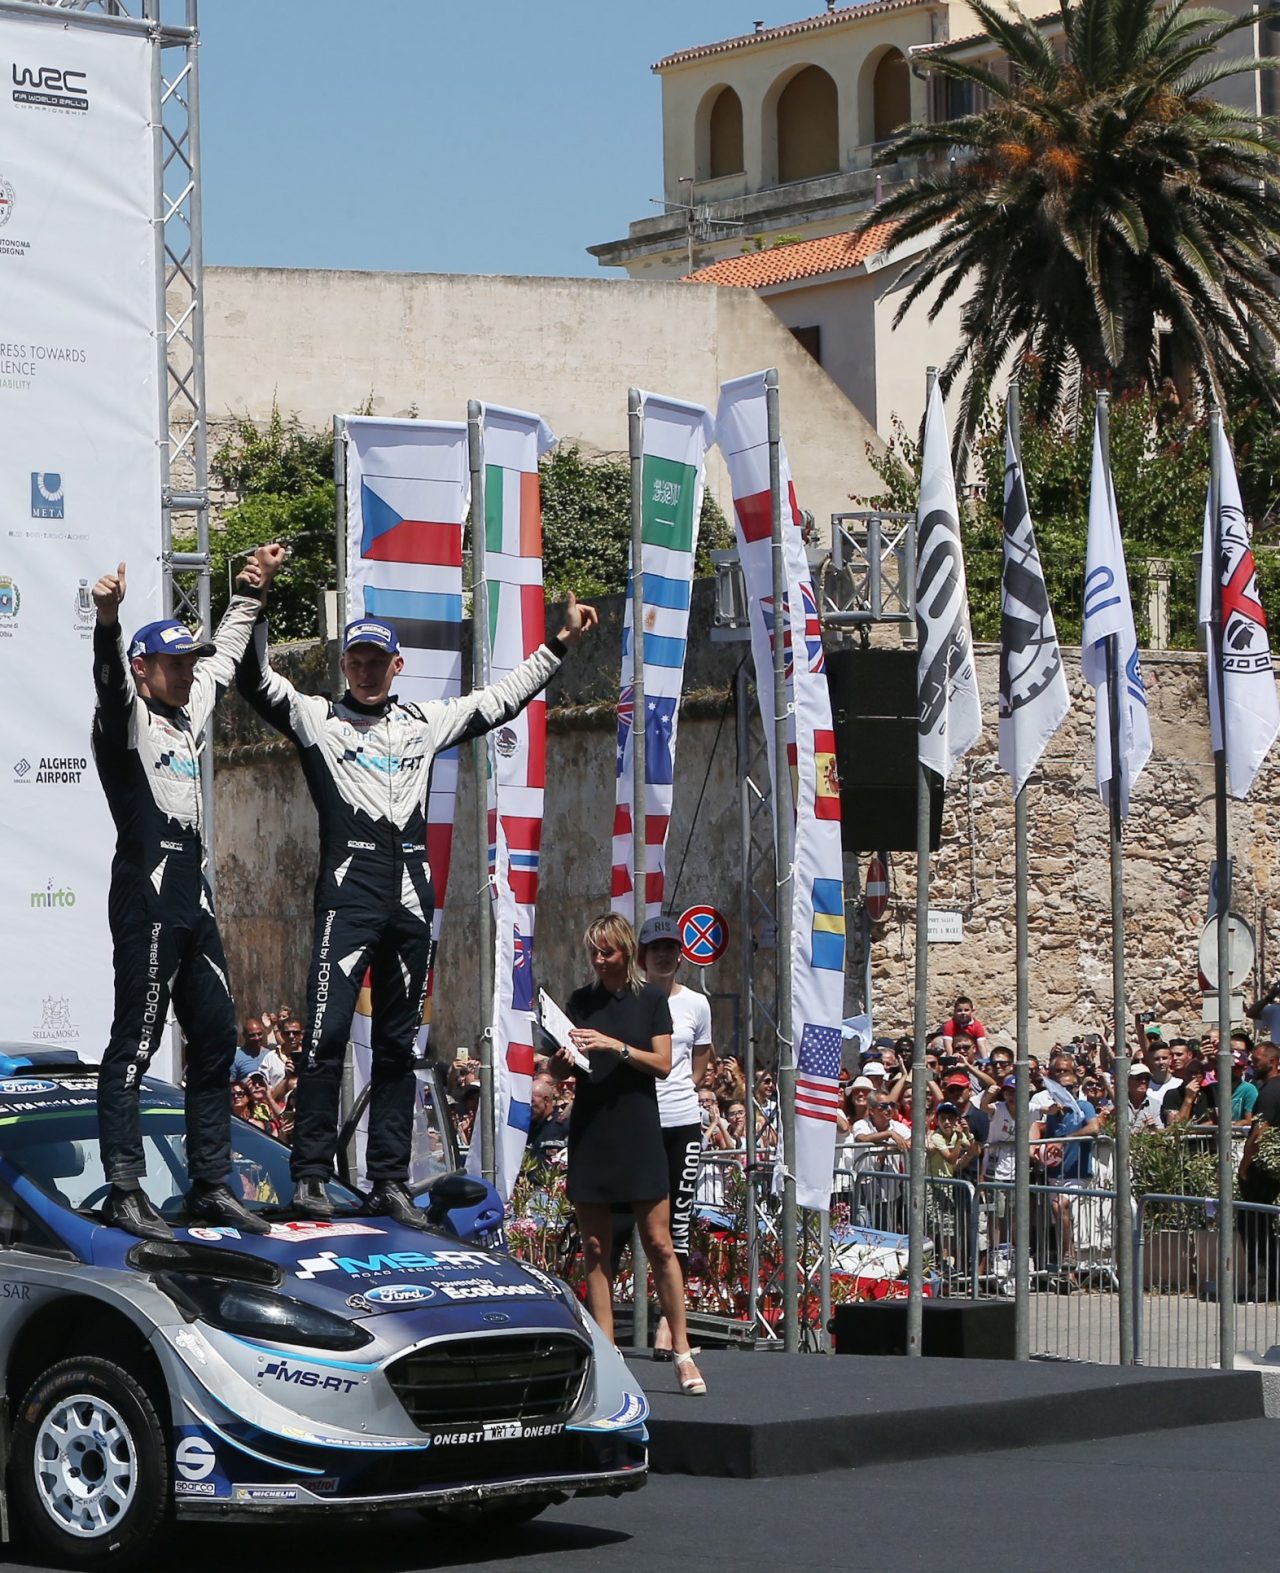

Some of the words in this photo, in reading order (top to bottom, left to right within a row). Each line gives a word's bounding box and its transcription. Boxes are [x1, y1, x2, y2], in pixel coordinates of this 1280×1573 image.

[13, 63, 88, 94] WRC
[28, 95, 58, 104] WORLD
[59, 97, 88, 108] RALLY
[15, 104, 88, 116] CHAMPIONSHIP
[30, 346, 86, 363] TOWARDS
[32, 508, 63, 518] META
[39, 758, 87, 770] ALGHERO
[36, 772, 82, 783] AIRPORT
[321, 910, 336, 947] Powered
[150, 922, 161, 966] Powered
[320, 948, 330, 960] by
[148, 966, 160, 980] by
[317, 962, 331, 1002] FORD
[144, 982, 160, 1024] FORD
[2, 1080, 48, 1092] Ford
[16, 1102, 34, 1111] FIA
[679, 1141, 701, 1193] FOOD
[333, 1251, 500, 1274] MS-RT
[350, 1270, 392, 1279] ROAD
[399, 1264, 482, 1275] TECHNOLOGY
[431, 1278, 474, 1289] Powered
[476, 1277, 494, 1286] by
[378, 1286, 424, 1301] Ford
[441, 1283, 544, 1300] EcoBoost
[276, 1367, 359, 1394] MS-RT
[434, 1432, 483, 1446] ONEBET
[524, 1423, 565, 1438] ONEBET
[325, 1437, 408, 1447] MICHELIN
[176, 1481, 214, 1494] sparco
[252, 1490, 296, 1498] MICHELIN
